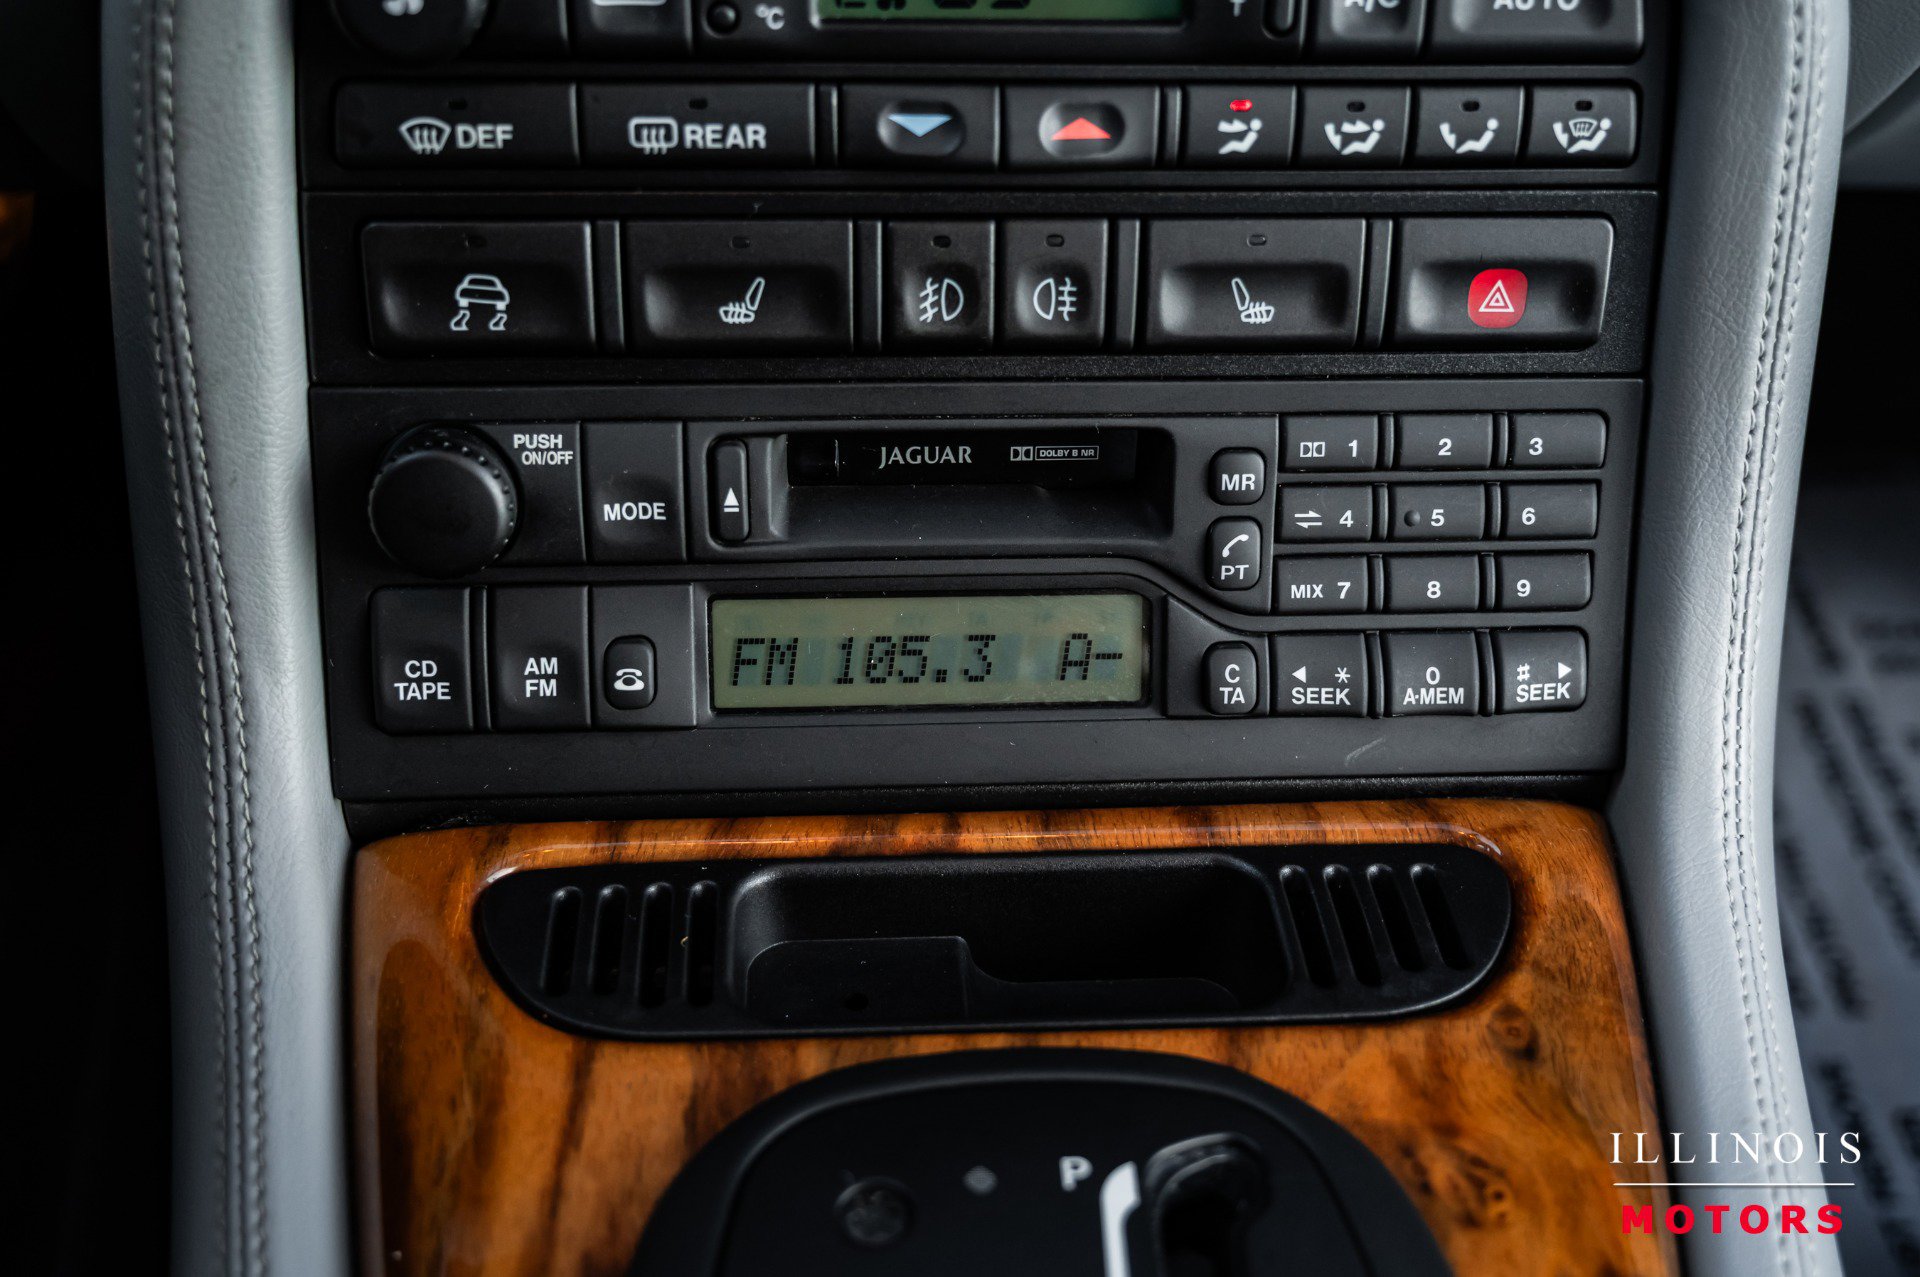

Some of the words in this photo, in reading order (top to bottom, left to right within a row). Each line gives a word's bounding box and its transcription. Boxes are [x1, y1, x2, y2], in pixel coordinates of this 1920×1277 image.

[755, 4, 786, 30] °C
[455, 123, 514, 150] DEF
[684, 123, 767, 149] REAR
[513, 433, 563, 449] PUSH
[1348, 439, 1358, 458] 1
[1437, 437, 1452, 456] 2
[1528, 437, 1543, 456] 3
[521, 450, 574, 466] ON/OFF
[878, 445, 973, 469] JAGUAR
[1039, 449, 1070, 457] DOLBY
[1071, 449, 1079, 457] B
[1080, 449, 1095, 457] NR
[1221, 473, 1256, 491] MR
[603, 501, 667, 522] MODE
[1339, 509, 1354, 528] 4
[1430, 508, 1445, 527] 5
[1521, 507, 1536, 526] 6
[1220, 564, 1250, 581] PT
[1290, 583, 1324, 600] MIX
[1337, 581, 1351, 600] 7
[1426, 580, 1442, 599] 8
[1516, 579, 1531, 598] 9
[404, 659, 438, 679] CD
[523, 657, 558, 676] AM
[731, 637, 799, 686] FM
[835, 635, 996, 684] 105.3
[1223, 663, 1241, 683] C
[393, 681, 452, 701] TAPE
[524, 678, 558, 698] FM
[1218, 686, 1246, 705] TA
[1291, 686, 1352, 706] SEEK
[1515, 682, 1572, 703] SEEK
[1060, 1156, 1093, 1191] P
